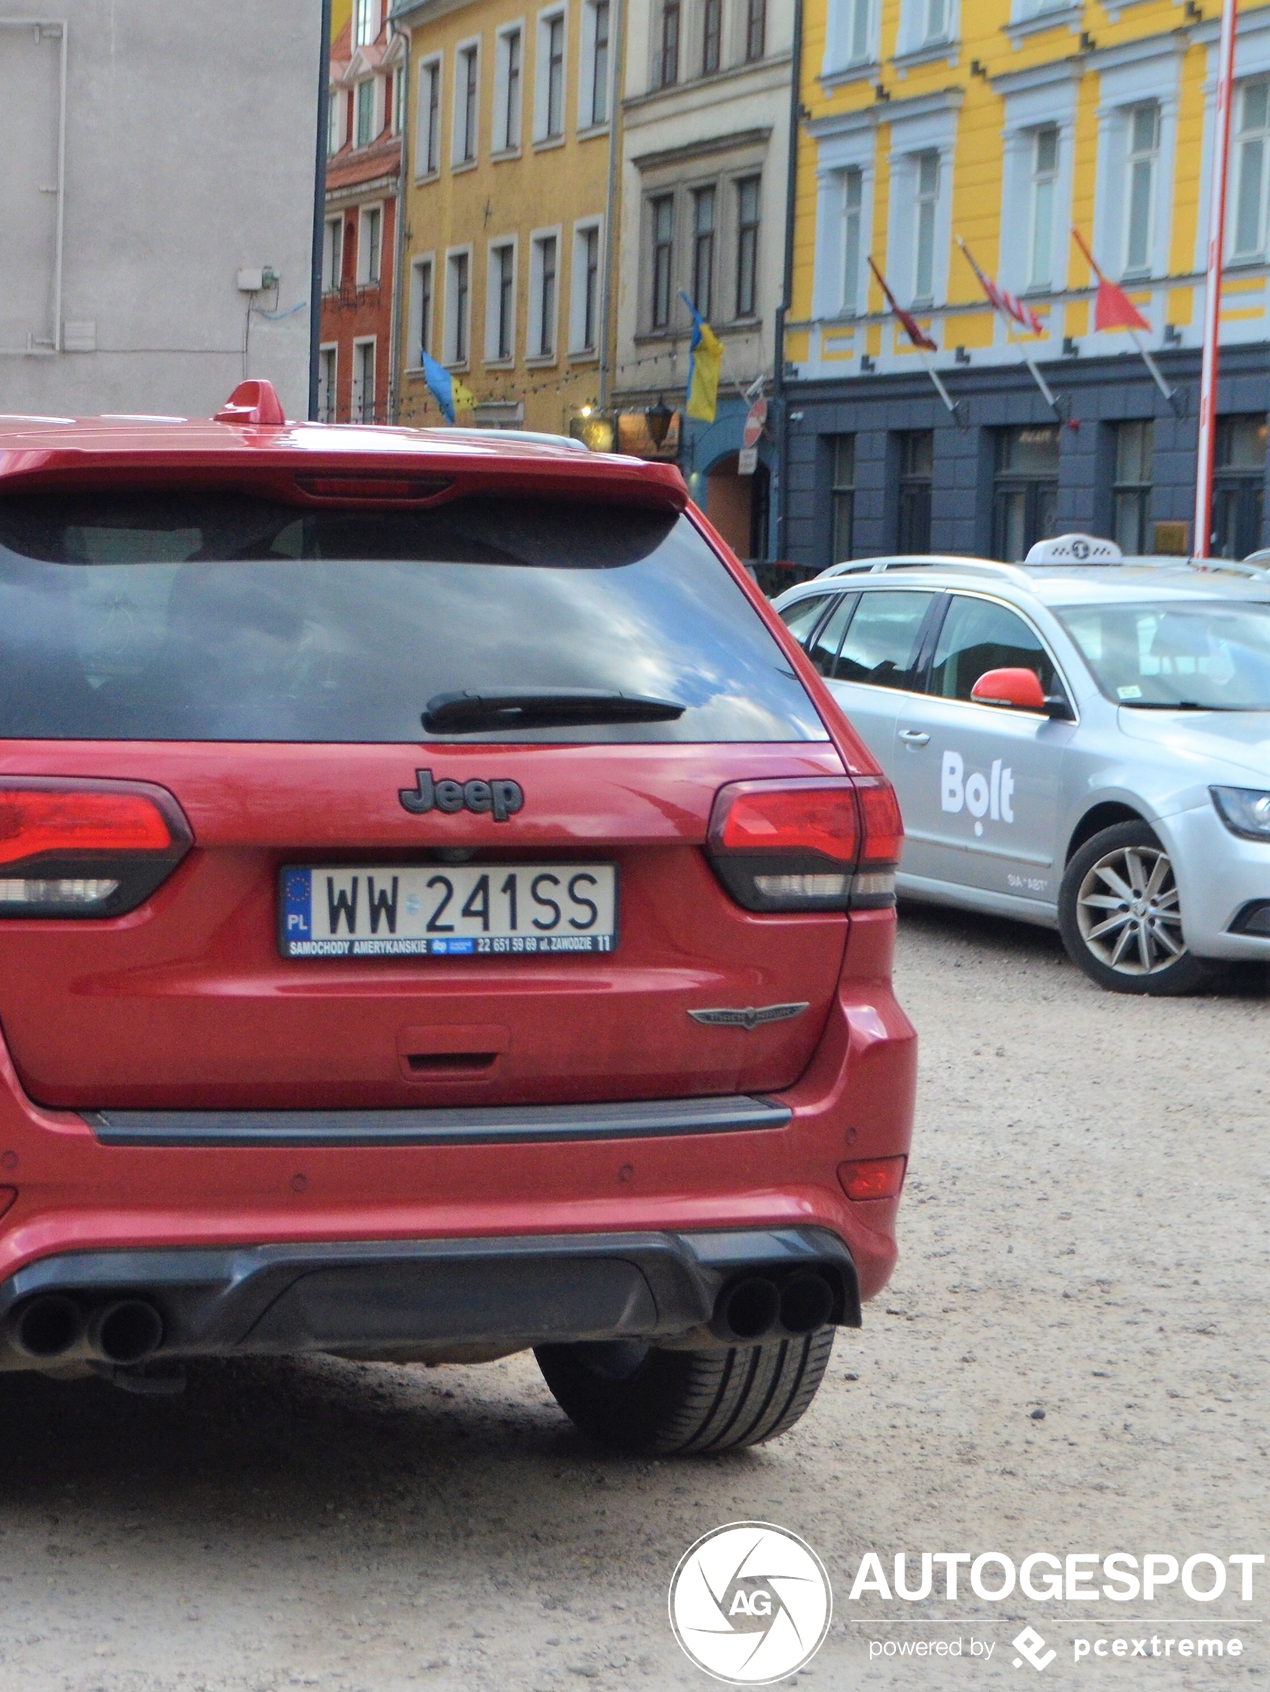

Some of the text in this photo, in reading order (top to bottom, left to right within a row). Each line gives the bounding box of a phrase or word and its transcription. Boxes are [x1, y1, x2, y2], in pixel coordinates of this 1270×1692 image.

[399, 769, 524, 822] Jeep
[941, 750, 1014, 836] Bolt
[327, 873, 598, 934] WW 241SS
[287, 914, 308, 930] PL
[289, 940, 350, 955] SAMOCHODY
[478, 938, 490, 951] 22
[493, 938, 510, 951] 651
[512, 938, 524, 951] 59
[525, 937, 538, 950] 69
[551, 936, 592, 950] ZAWODZIE
[597, 935, 611, 951] 11
